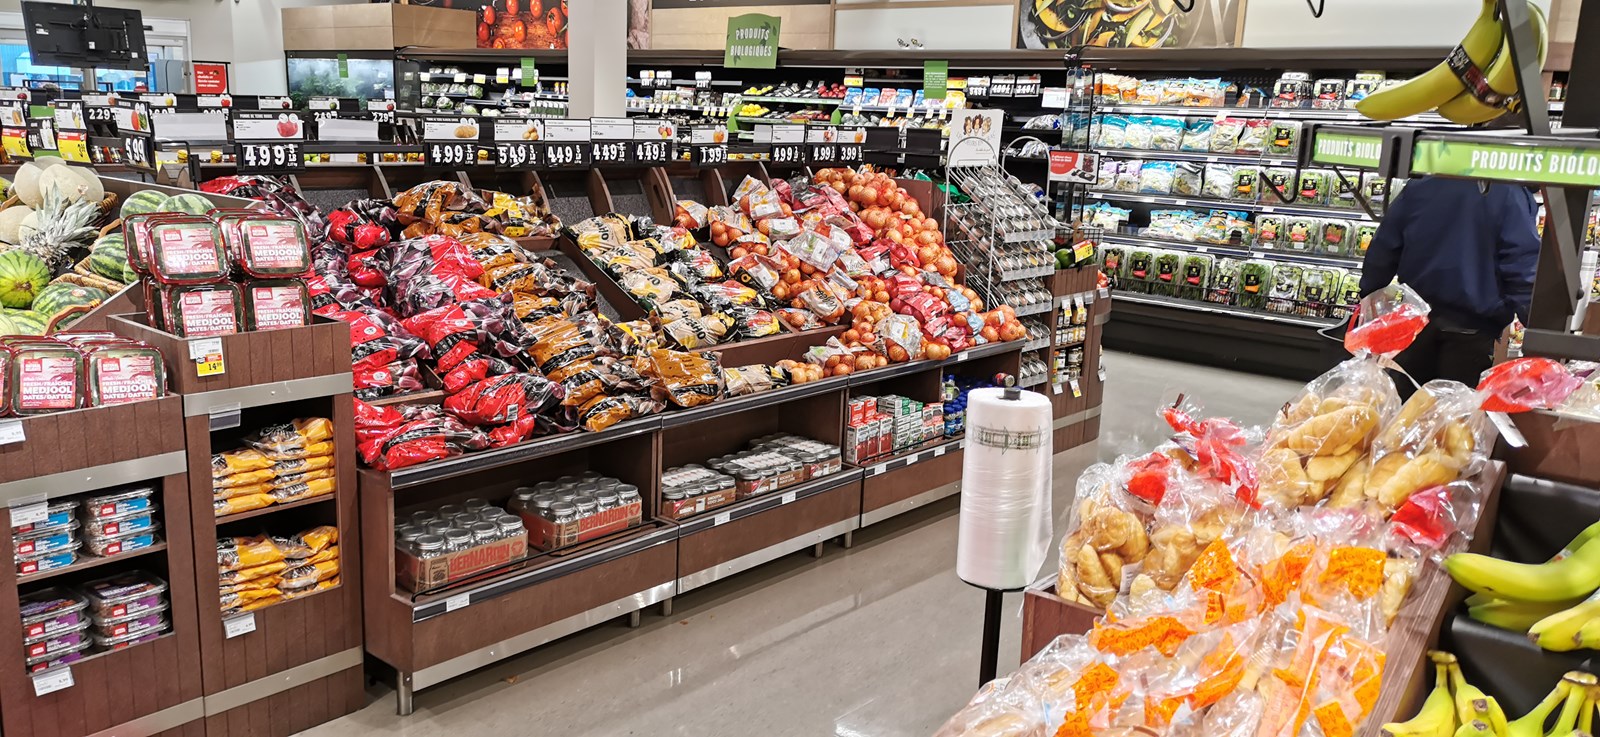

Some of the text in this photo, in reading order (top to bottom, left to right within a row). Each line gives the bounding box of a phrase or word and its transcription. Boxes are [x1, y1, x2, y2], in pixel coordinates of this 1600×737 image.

[735, 28, 770, 41] PRODUITS
[730, 45, 773, 57] BIOLOGIQUES
[1317, 138, 1354, 158] PRODUITS
[1471, 150, 1600, 176] PRODUITS BIOLO
[187, 317, 234, 327] MEDJOOL
[258, 313, 302, 321] MEDJOOL
[23, 386, 72, 394] MEDJOOL
[102, 384, 154, 394] MEDJOOL
[580, 505, 628, 530] BERNARDIN
[449, 544, 510, 572] BERNARDIN
